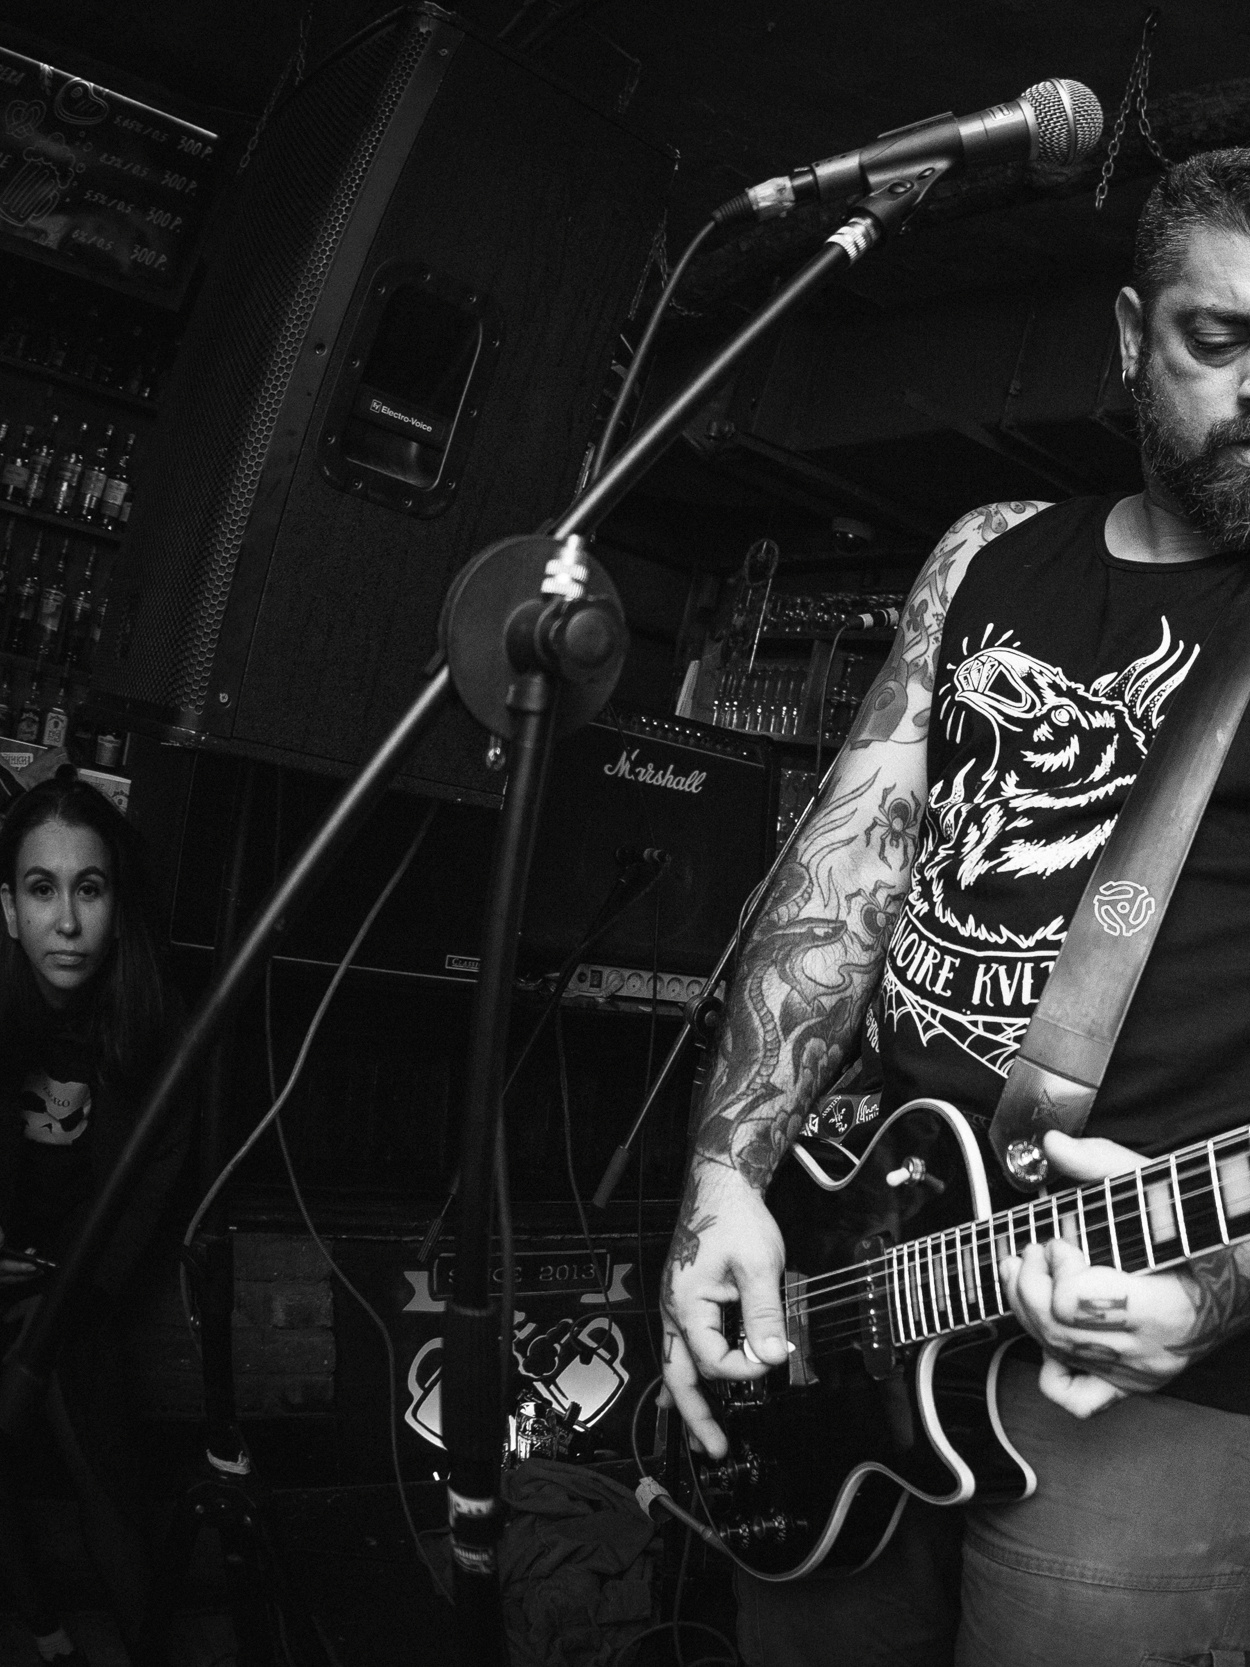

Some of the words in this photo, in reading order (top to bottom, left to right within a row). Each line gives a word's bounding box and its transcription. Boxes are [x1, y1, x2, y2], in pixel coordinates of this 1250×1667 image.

[381, 405, 432, 432] Electro-Voice
[603, 748, 707, 794] Marshall
[538, 1263, 596, 1282] 2013
